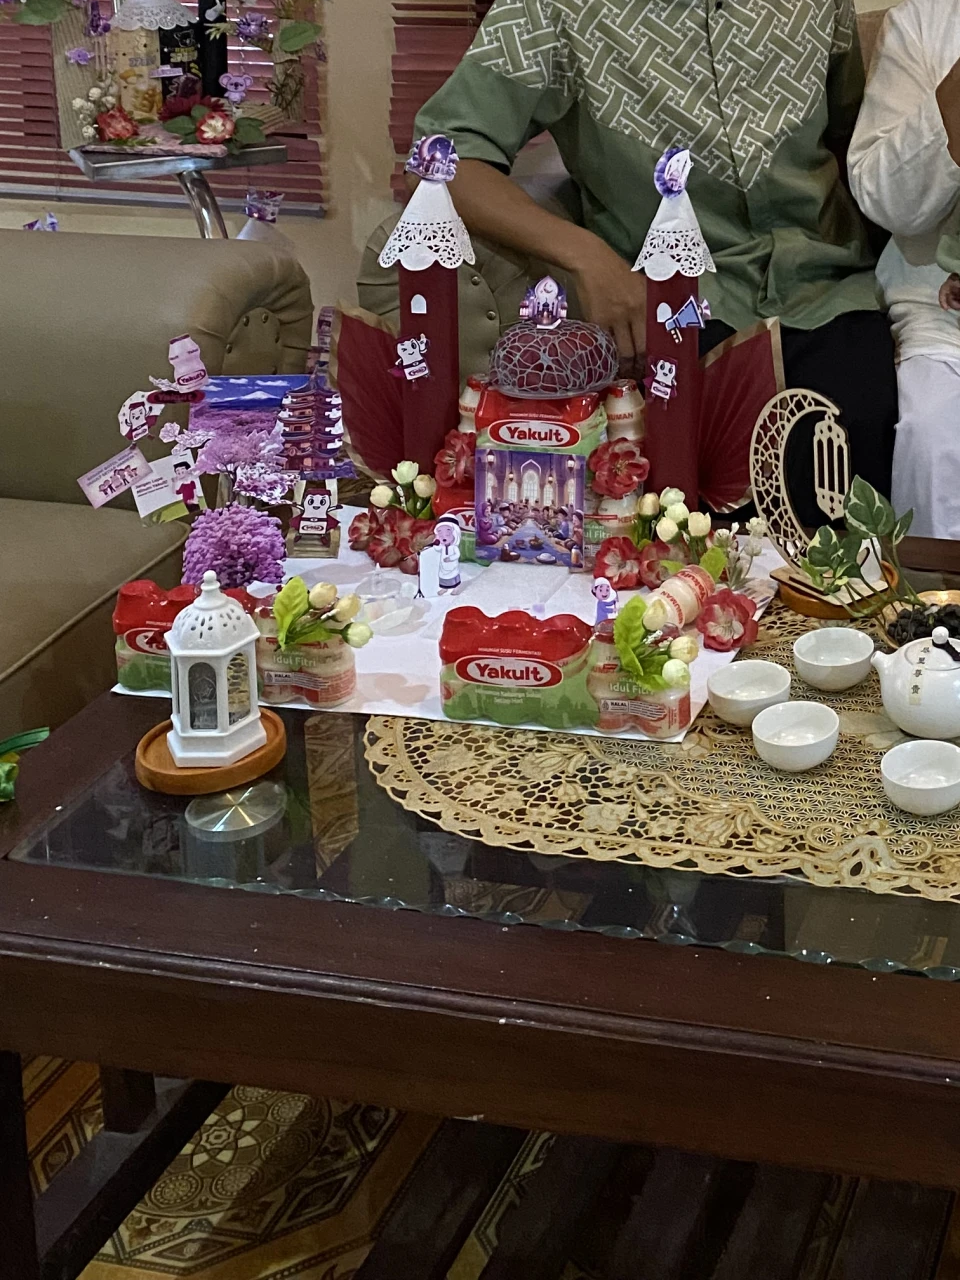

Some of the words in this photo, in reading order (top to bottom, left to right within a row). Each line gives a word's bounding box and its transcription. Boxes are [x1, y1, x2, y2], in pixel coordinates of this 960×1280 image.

[506, 426, 564, 443] Yakult
[273, 654, 293, 664] Idul
[295, 656, 316, 667] Fitri
[474, 662, 545, 683] Yakult
[609, 682, 630, 693] Idul
